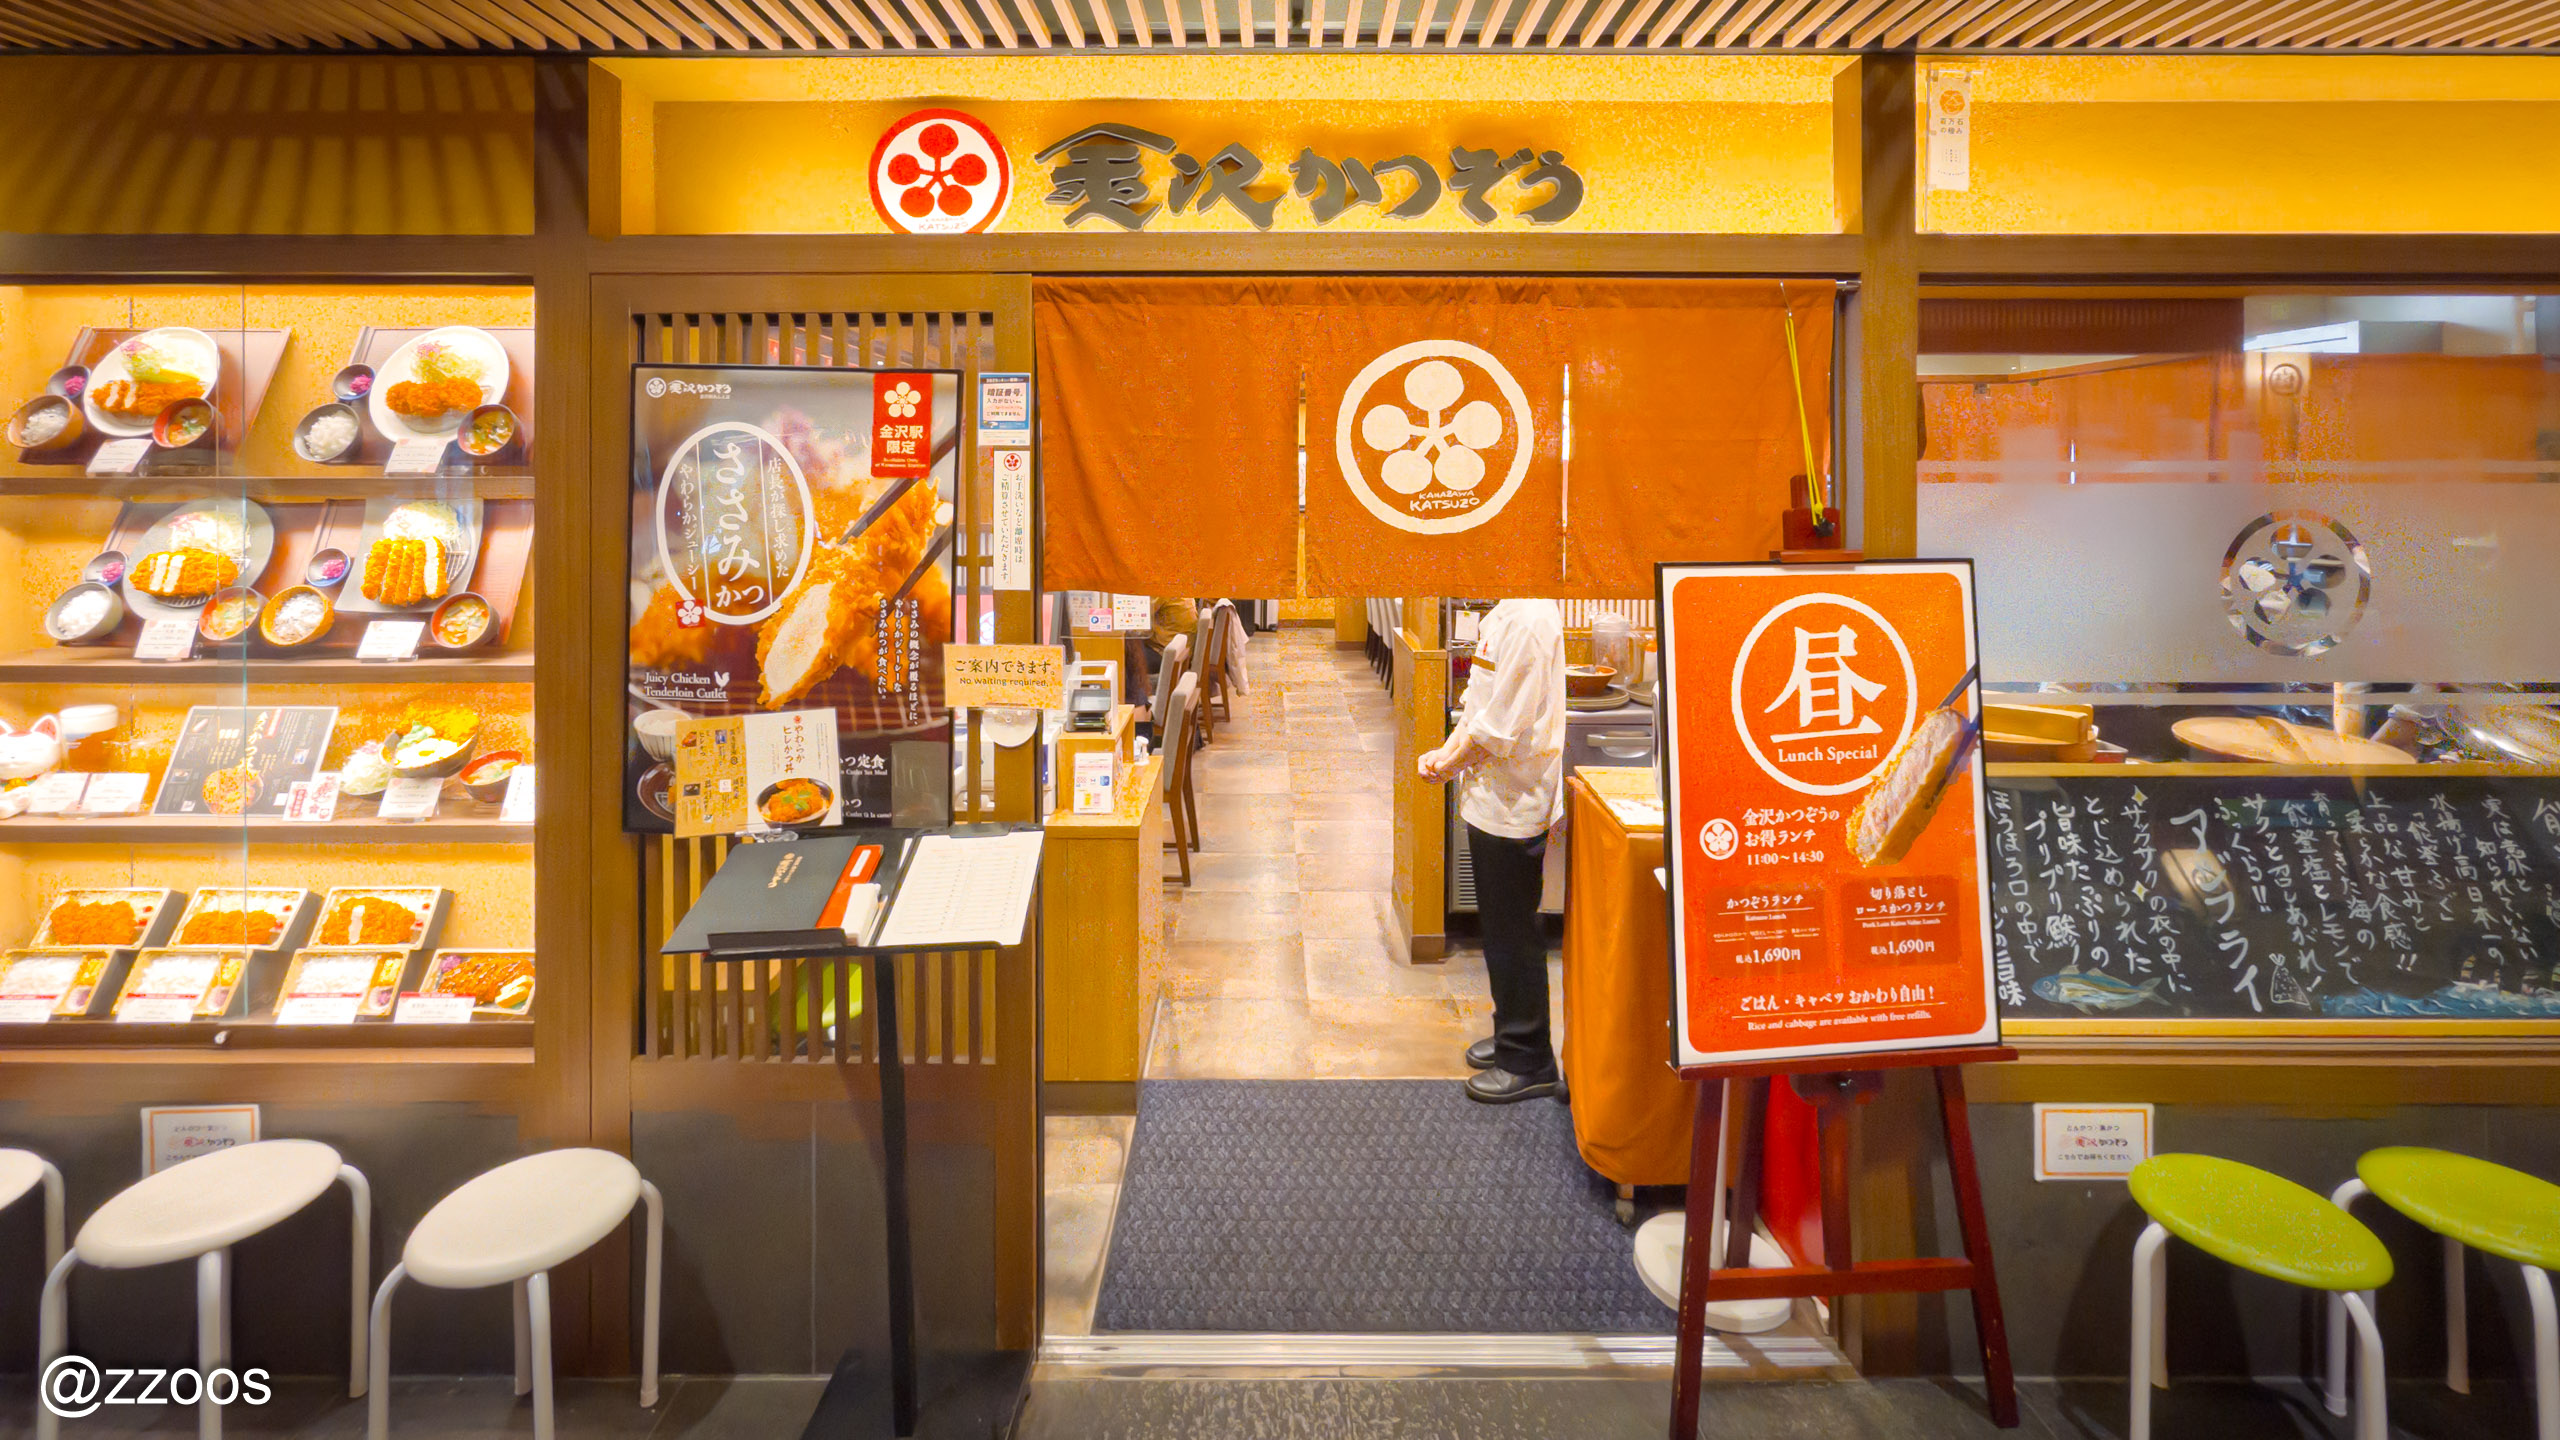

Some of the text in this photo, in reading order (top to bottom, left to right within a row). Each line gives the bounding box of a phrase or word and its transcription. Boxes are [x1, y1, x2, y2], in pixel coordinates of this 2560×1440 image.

[1034, 122, 1585, 231] 金沢かつぞう
[880, 424, 923, 439] 金沢駅
[886, 440, 916, 455] 限定
[713, 442, 760, 582] ささみ
[1409, 497, 1481, 512] KATSUZO
[679, 464, 700, 591] やわらかジューシー
[768, 457, 790, 579] 店長が探し求めた
[715, 584, 765, 608] かつ
[877, 598, 888, 700] ささみかつが食べたい。
[893, 598, 905, 693] やわらかジューシーな
[954, 658, 1055, 675] ご案内できます。
[644, 671, 711, 686] Juicy Chicken
[960, 677, 1049, 687] No waiting required.
[1763, 623, 1888, 744] 昼
[644, 686, 727, 699] Tenderloin Cutlet
[840, 753, 885, 770] つ定食
[1778, 744, 1878, 764] Lunch Special
[1741, 806, 1841, 827] 金沢かつぞうの
[1744, 829, 1816, 848] お得ランチ
[2366, 790, 2431, 932] 上品な甘みと
[1870, 884, 1928, 901] 切り落とし
[2051, 801, 2110, 968] 旨味たっぷりの
[2083, 795, 2152, 974] とじ込められた
[1726, 894, 1804, 910] かつぞうランチ
[1856, 900, 1946, 915] ロースかつランチ
[1748, 1021, 1766, 1030] Rice
[1768, 1020, 1783, 1029] and
[1785, 1018, 1817, 1030] cabbage
[1819, 1018, 1832, 1027] are
[1834, 1015, 1869, 1026] available
[1870, 1013, 1888, 1023] with
[1890, 1012, 1905, 1022] free
